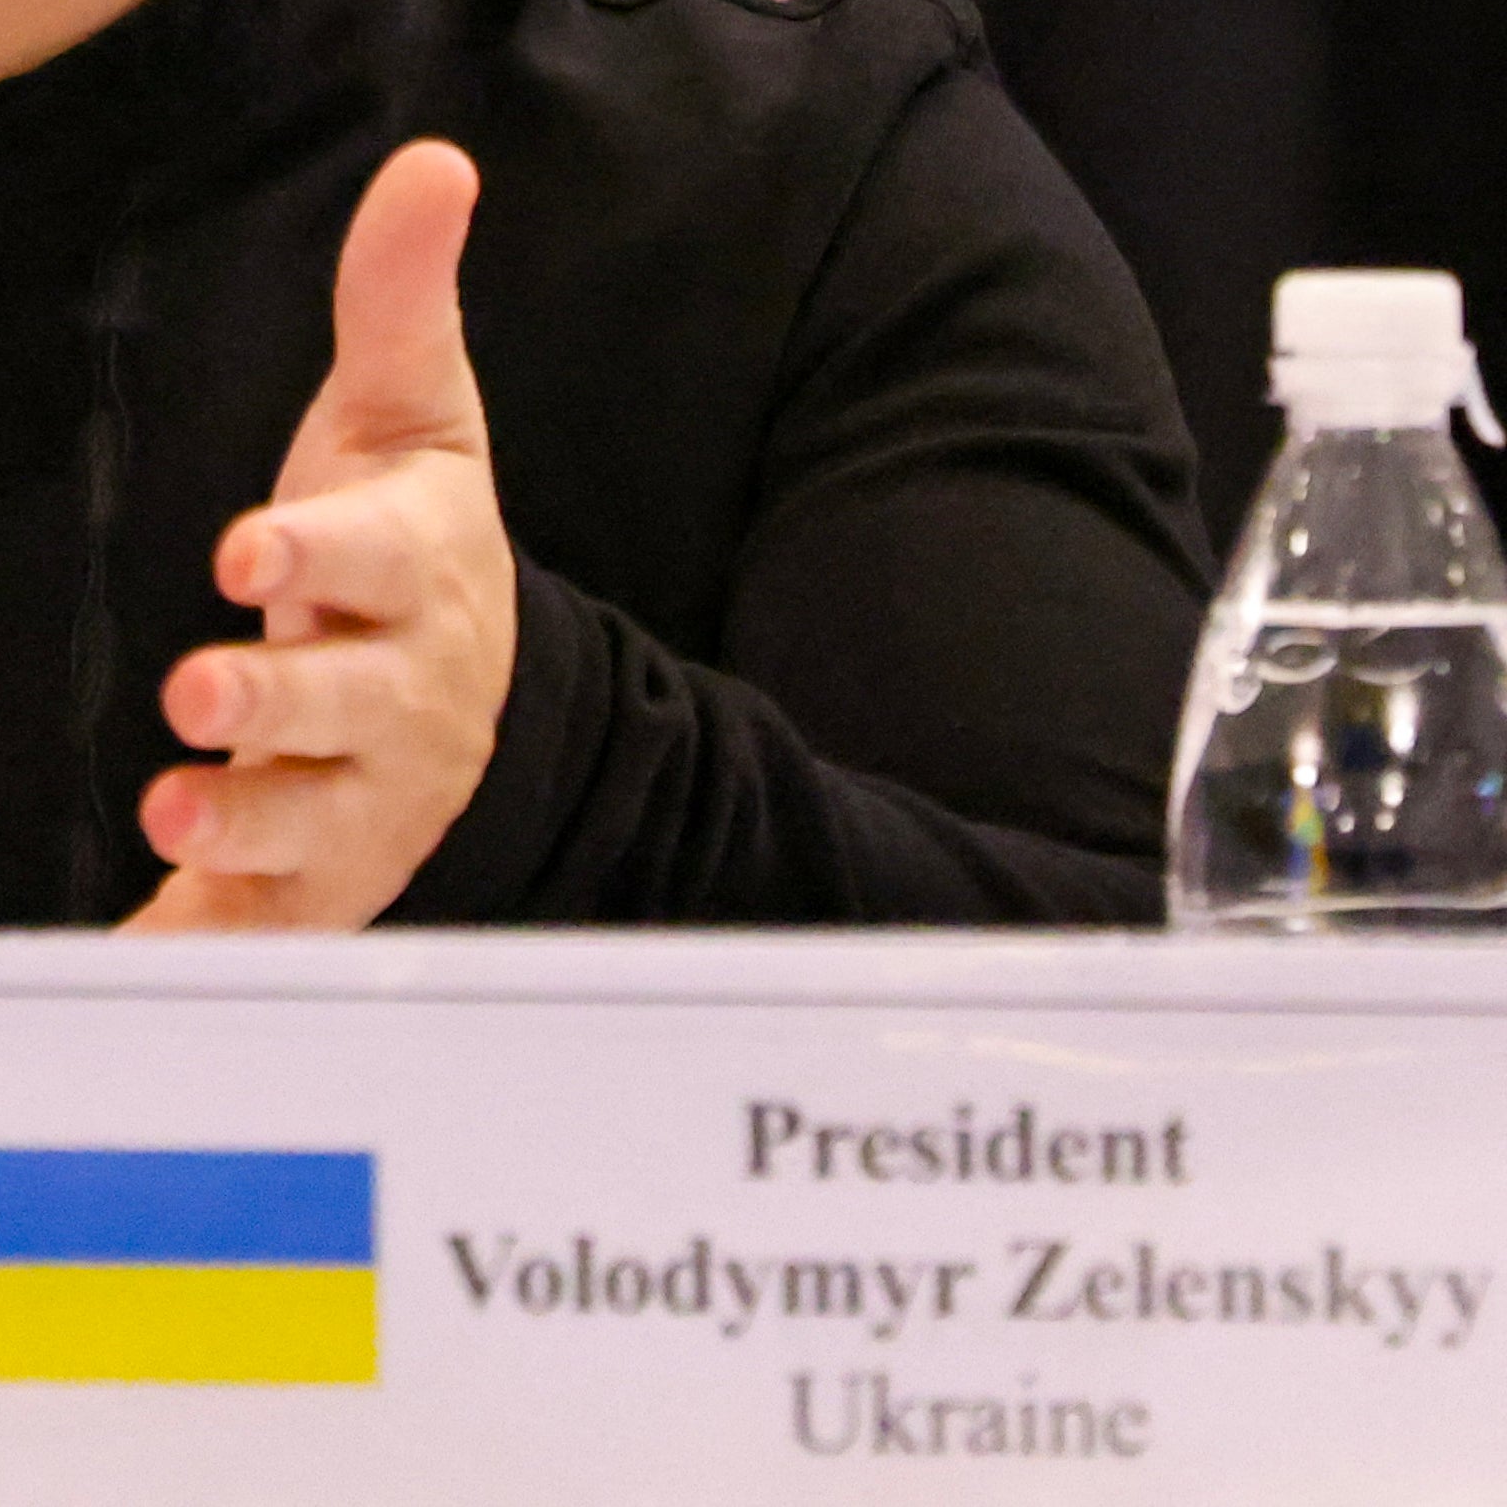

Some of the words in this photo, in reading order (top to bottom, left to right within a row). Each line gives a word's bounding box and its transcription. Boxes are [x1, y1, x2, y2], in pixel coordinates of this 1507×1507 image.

[744, 1099, 1191, 1184] President
[447, 1231, 977, 1340] Volodymyr
[1007, 1239, 1493, 1349] Zelenskyy
[792, 1369, 1152, 1458] Ukraine
